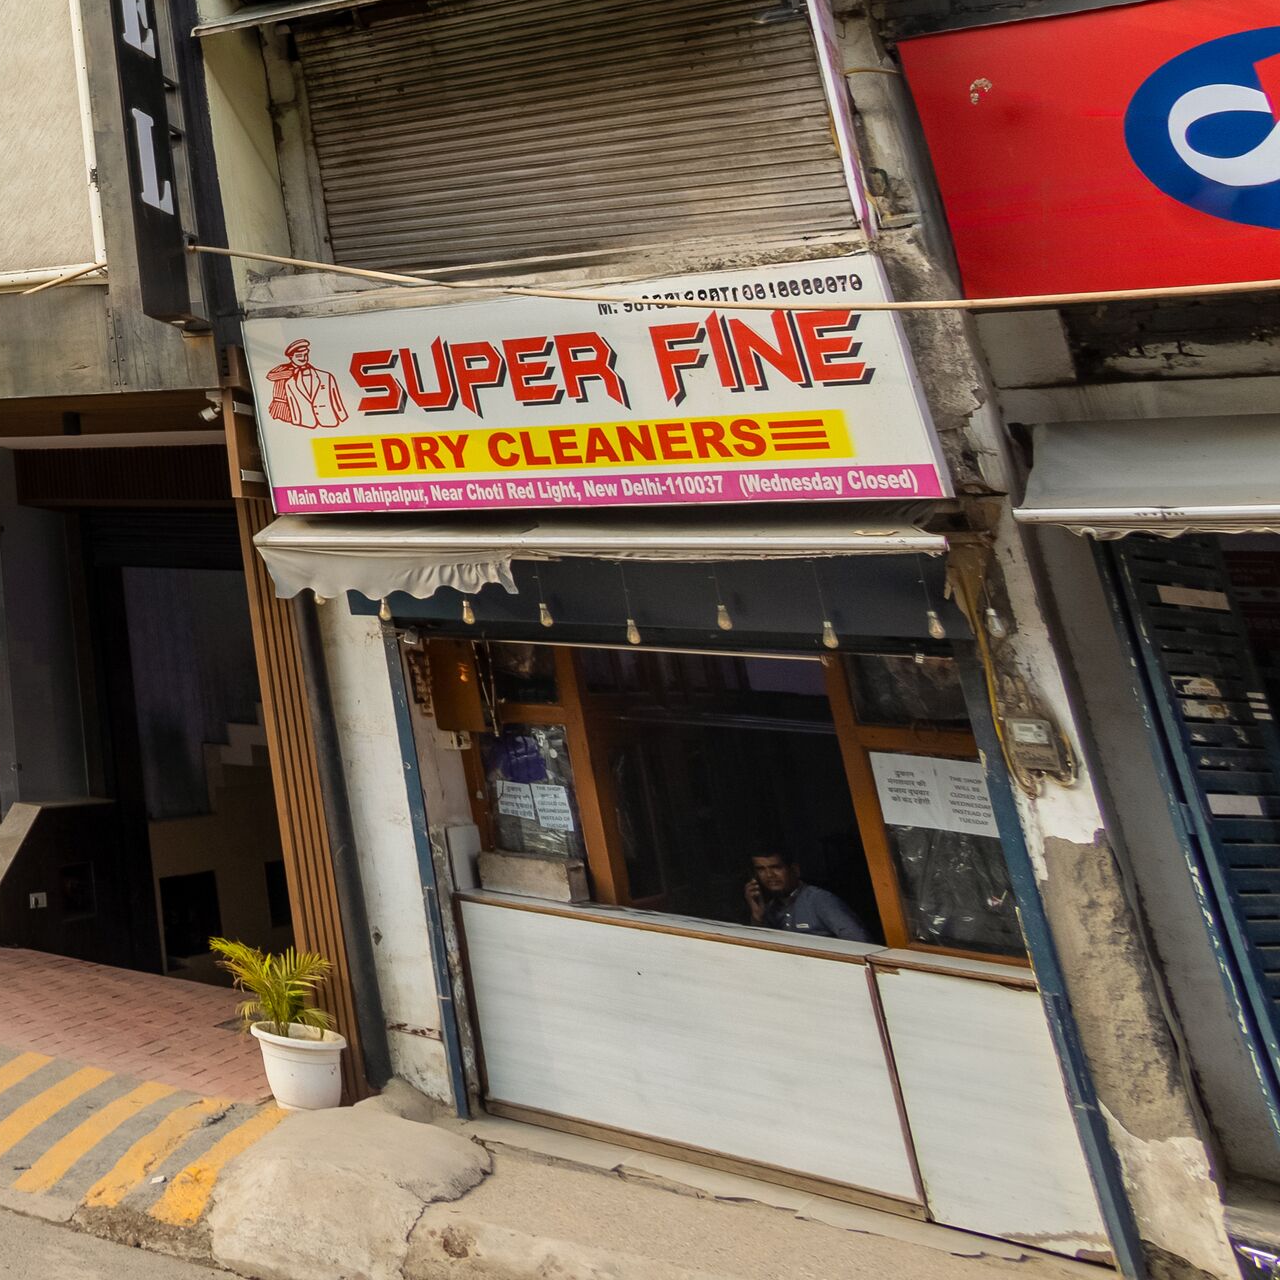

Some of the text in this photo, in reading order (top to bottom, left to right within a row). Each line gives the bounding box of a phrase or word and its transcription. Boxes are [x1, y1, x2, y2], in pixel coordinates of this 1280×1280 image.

[349, 309, 876, 418] SUPER FINE
[382, 418, 767, 471] DRY CLEANERS
[287, 469, 919, 507] Main Road Mahipalpur, Near Choti Red Light, New Delhi-110037 (Wednesday Closed)
